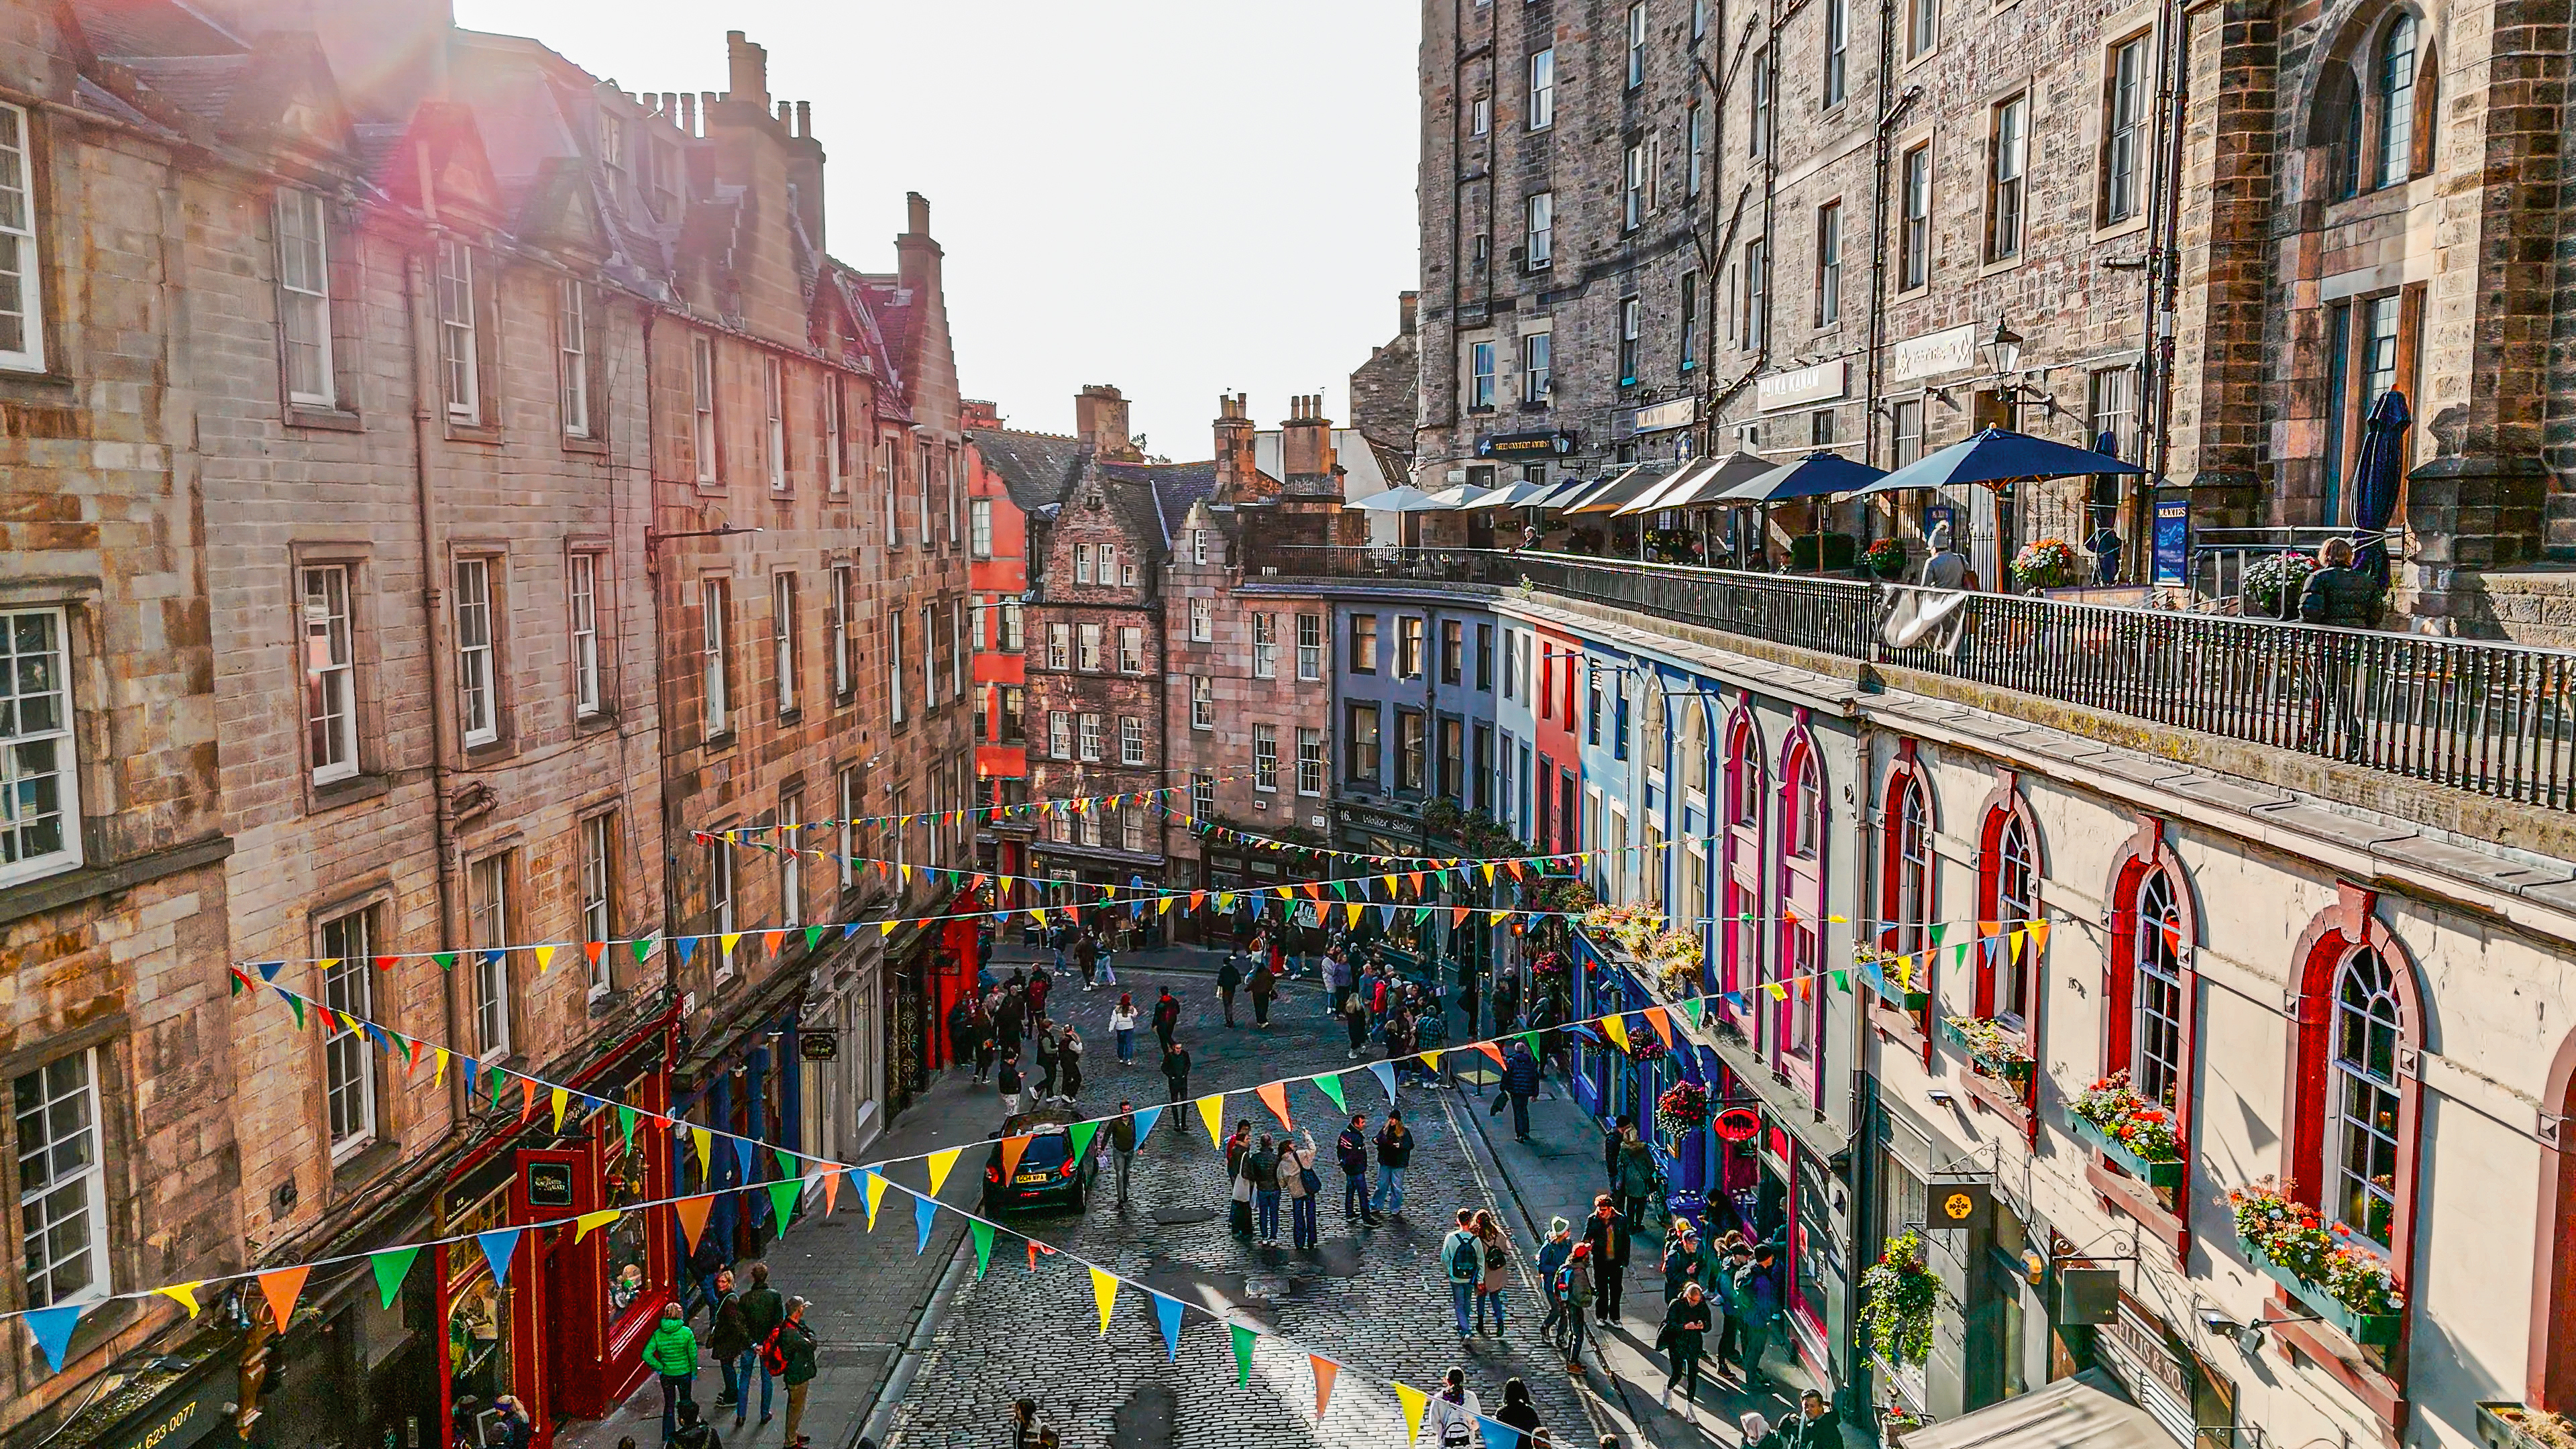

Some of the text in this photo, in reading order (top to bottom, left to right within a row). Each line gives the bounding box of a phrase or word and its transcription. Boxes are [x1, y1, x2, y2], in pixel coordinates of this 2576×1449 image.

[2158, 507, 2186, 518] MAXIES
[1362, 814, 1388, 827] Walker
[1392, 820, 1414, 833] Slater
[2152, 1350, 2161, 1375] &
[2163, 1360, 2186, 1398] SO
[145, 1424, 167, 1449] 623
[169, 1401, 197, 1432] 0077
